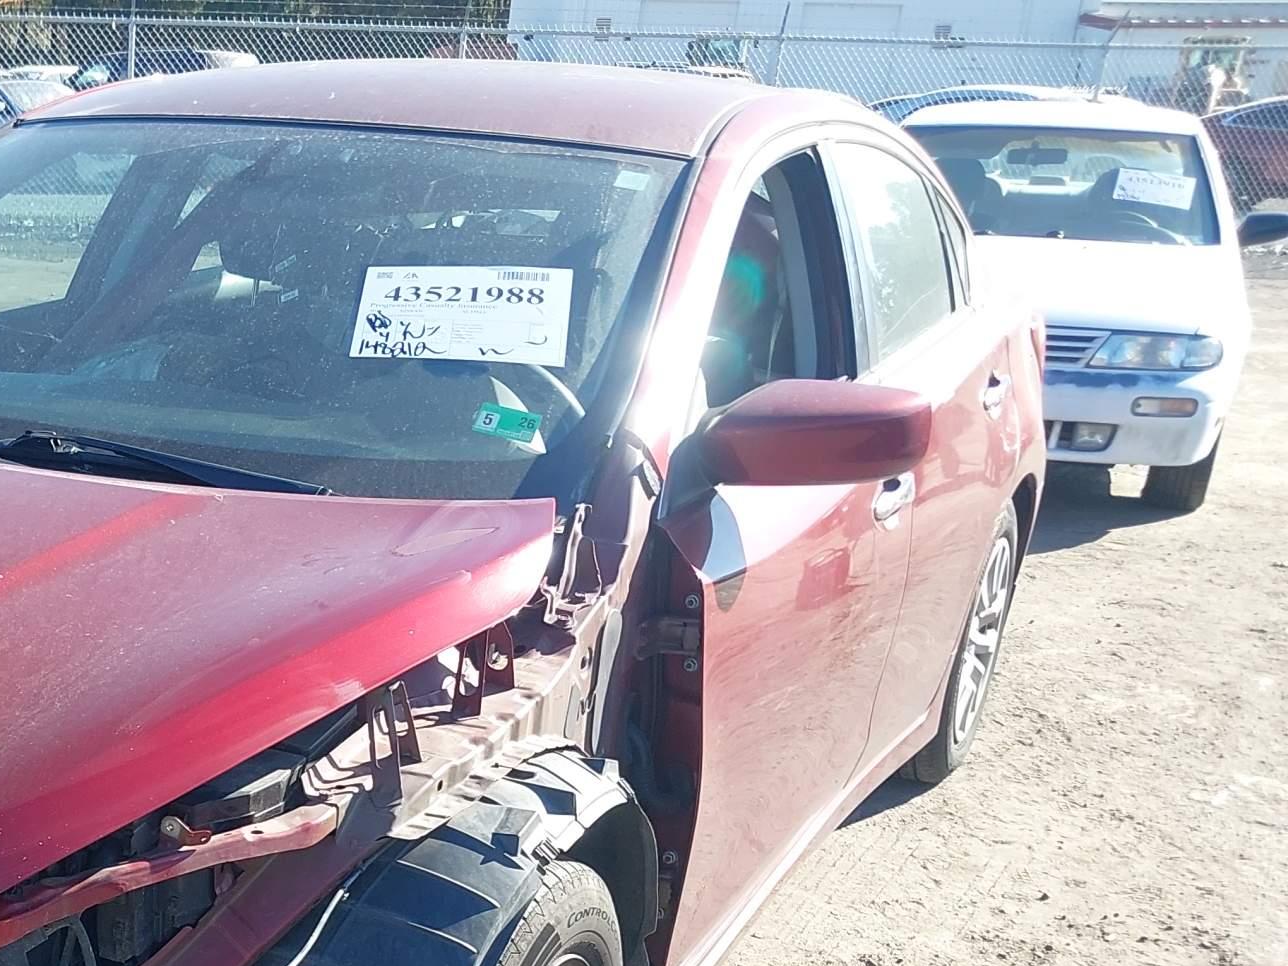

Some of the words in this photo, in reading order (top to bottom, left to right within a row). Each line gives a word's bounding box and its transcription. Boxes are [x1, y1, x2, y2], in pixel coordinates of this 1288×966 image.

[384, 286, 545, 304] 43521988
[482, 413, 495, 426] 5
[518, 416, 537, 429] 26
